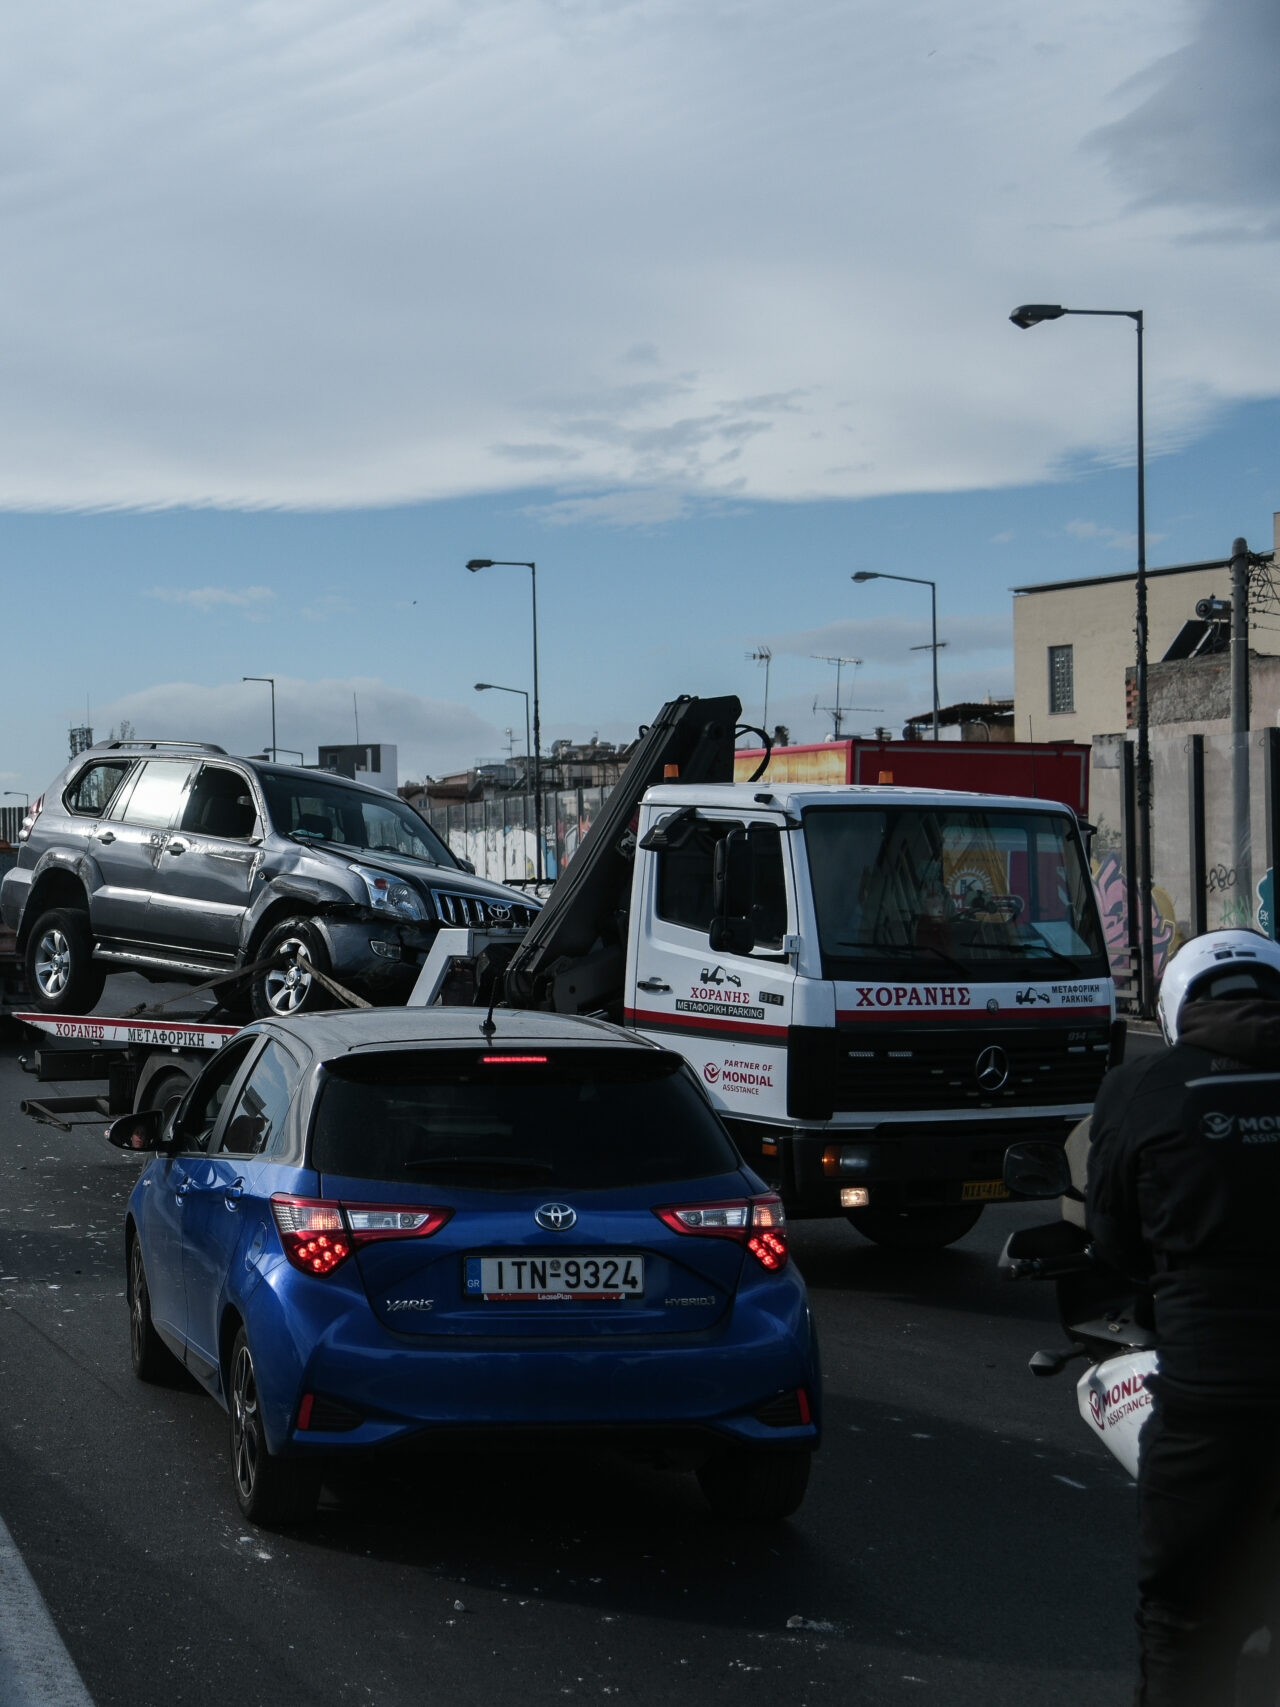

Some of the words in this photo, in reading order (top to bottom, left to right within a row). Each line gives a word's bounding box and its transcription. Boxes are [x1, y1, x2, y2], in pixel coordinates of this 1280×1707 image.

[690, 987, 750, 1004] ΧΟΡΑΝΗΣ
[1051, 984, 1100, 994] ΜΕΤΑΦΟΡΙΚΗ
[760, 992, 782, 1004] 814
[856, 987, 971, 1007] ΧΟΡΑΝΗΣ
[1061, 995, 1093, 1003] PARKING
[677, 1001, 727, 1015] ΜΕΤΑΦΟΡΙΚΗ
[728, 1006, 763, 1018] PARKING
[56, 1023, 104, 1039] ΧΟΡΑΝΗΣ
[127, 1028, 205, 1047] ΜΕΤΑΦΟΡΙΚΗ
[724, 1059, 760, 1071] PARTNER
[762, 1064, 773, 1072] OF
[722, 1071, 773, 1087] MONDIAL
[723, 1084, 760, 1096] ASSISTANCE
[497, 1259, 638, 1289] ITN-9324
[467, 1280, 480, 1288] GR
[537, 1293, 573, 1301] LeasePlan
[664, 1297, 708, 1307] HYBRID
[1107, 1393, 1152, 1428] ASSISTANCE
